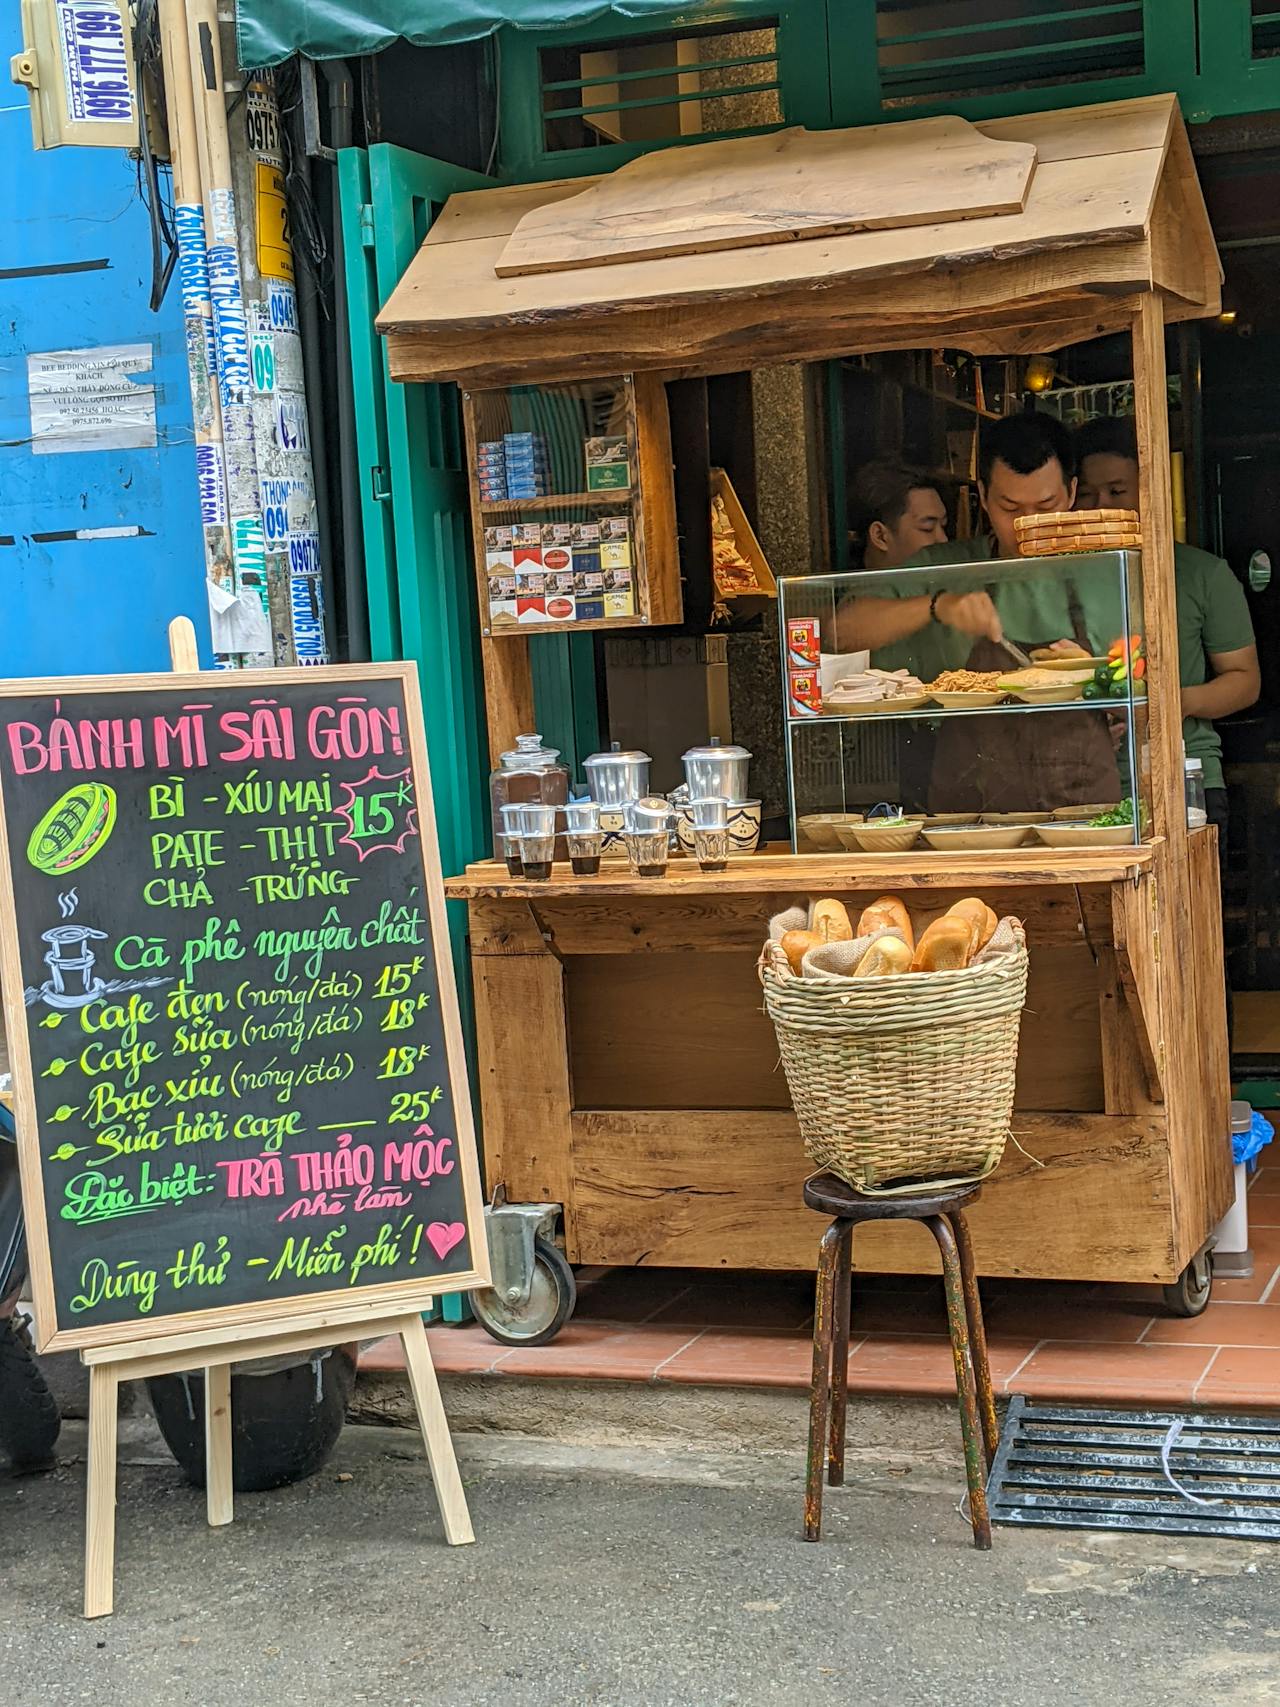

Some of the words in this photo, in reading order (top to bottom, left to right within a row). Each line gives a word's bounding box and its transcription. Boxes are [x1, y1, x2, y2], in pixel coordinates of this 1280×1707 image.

[75, 10, 132, 119] 0916.177.199
[153, 829, 225, 870] PATE
[180, 916, 246, 985] phê
[80, 993, 160, 1050] Cafe
[80, 1040, 164, 1089] Cafe
[289, 1133, 375, 1192] THẢO
[383, 1122, 455, 1187] MỘC
